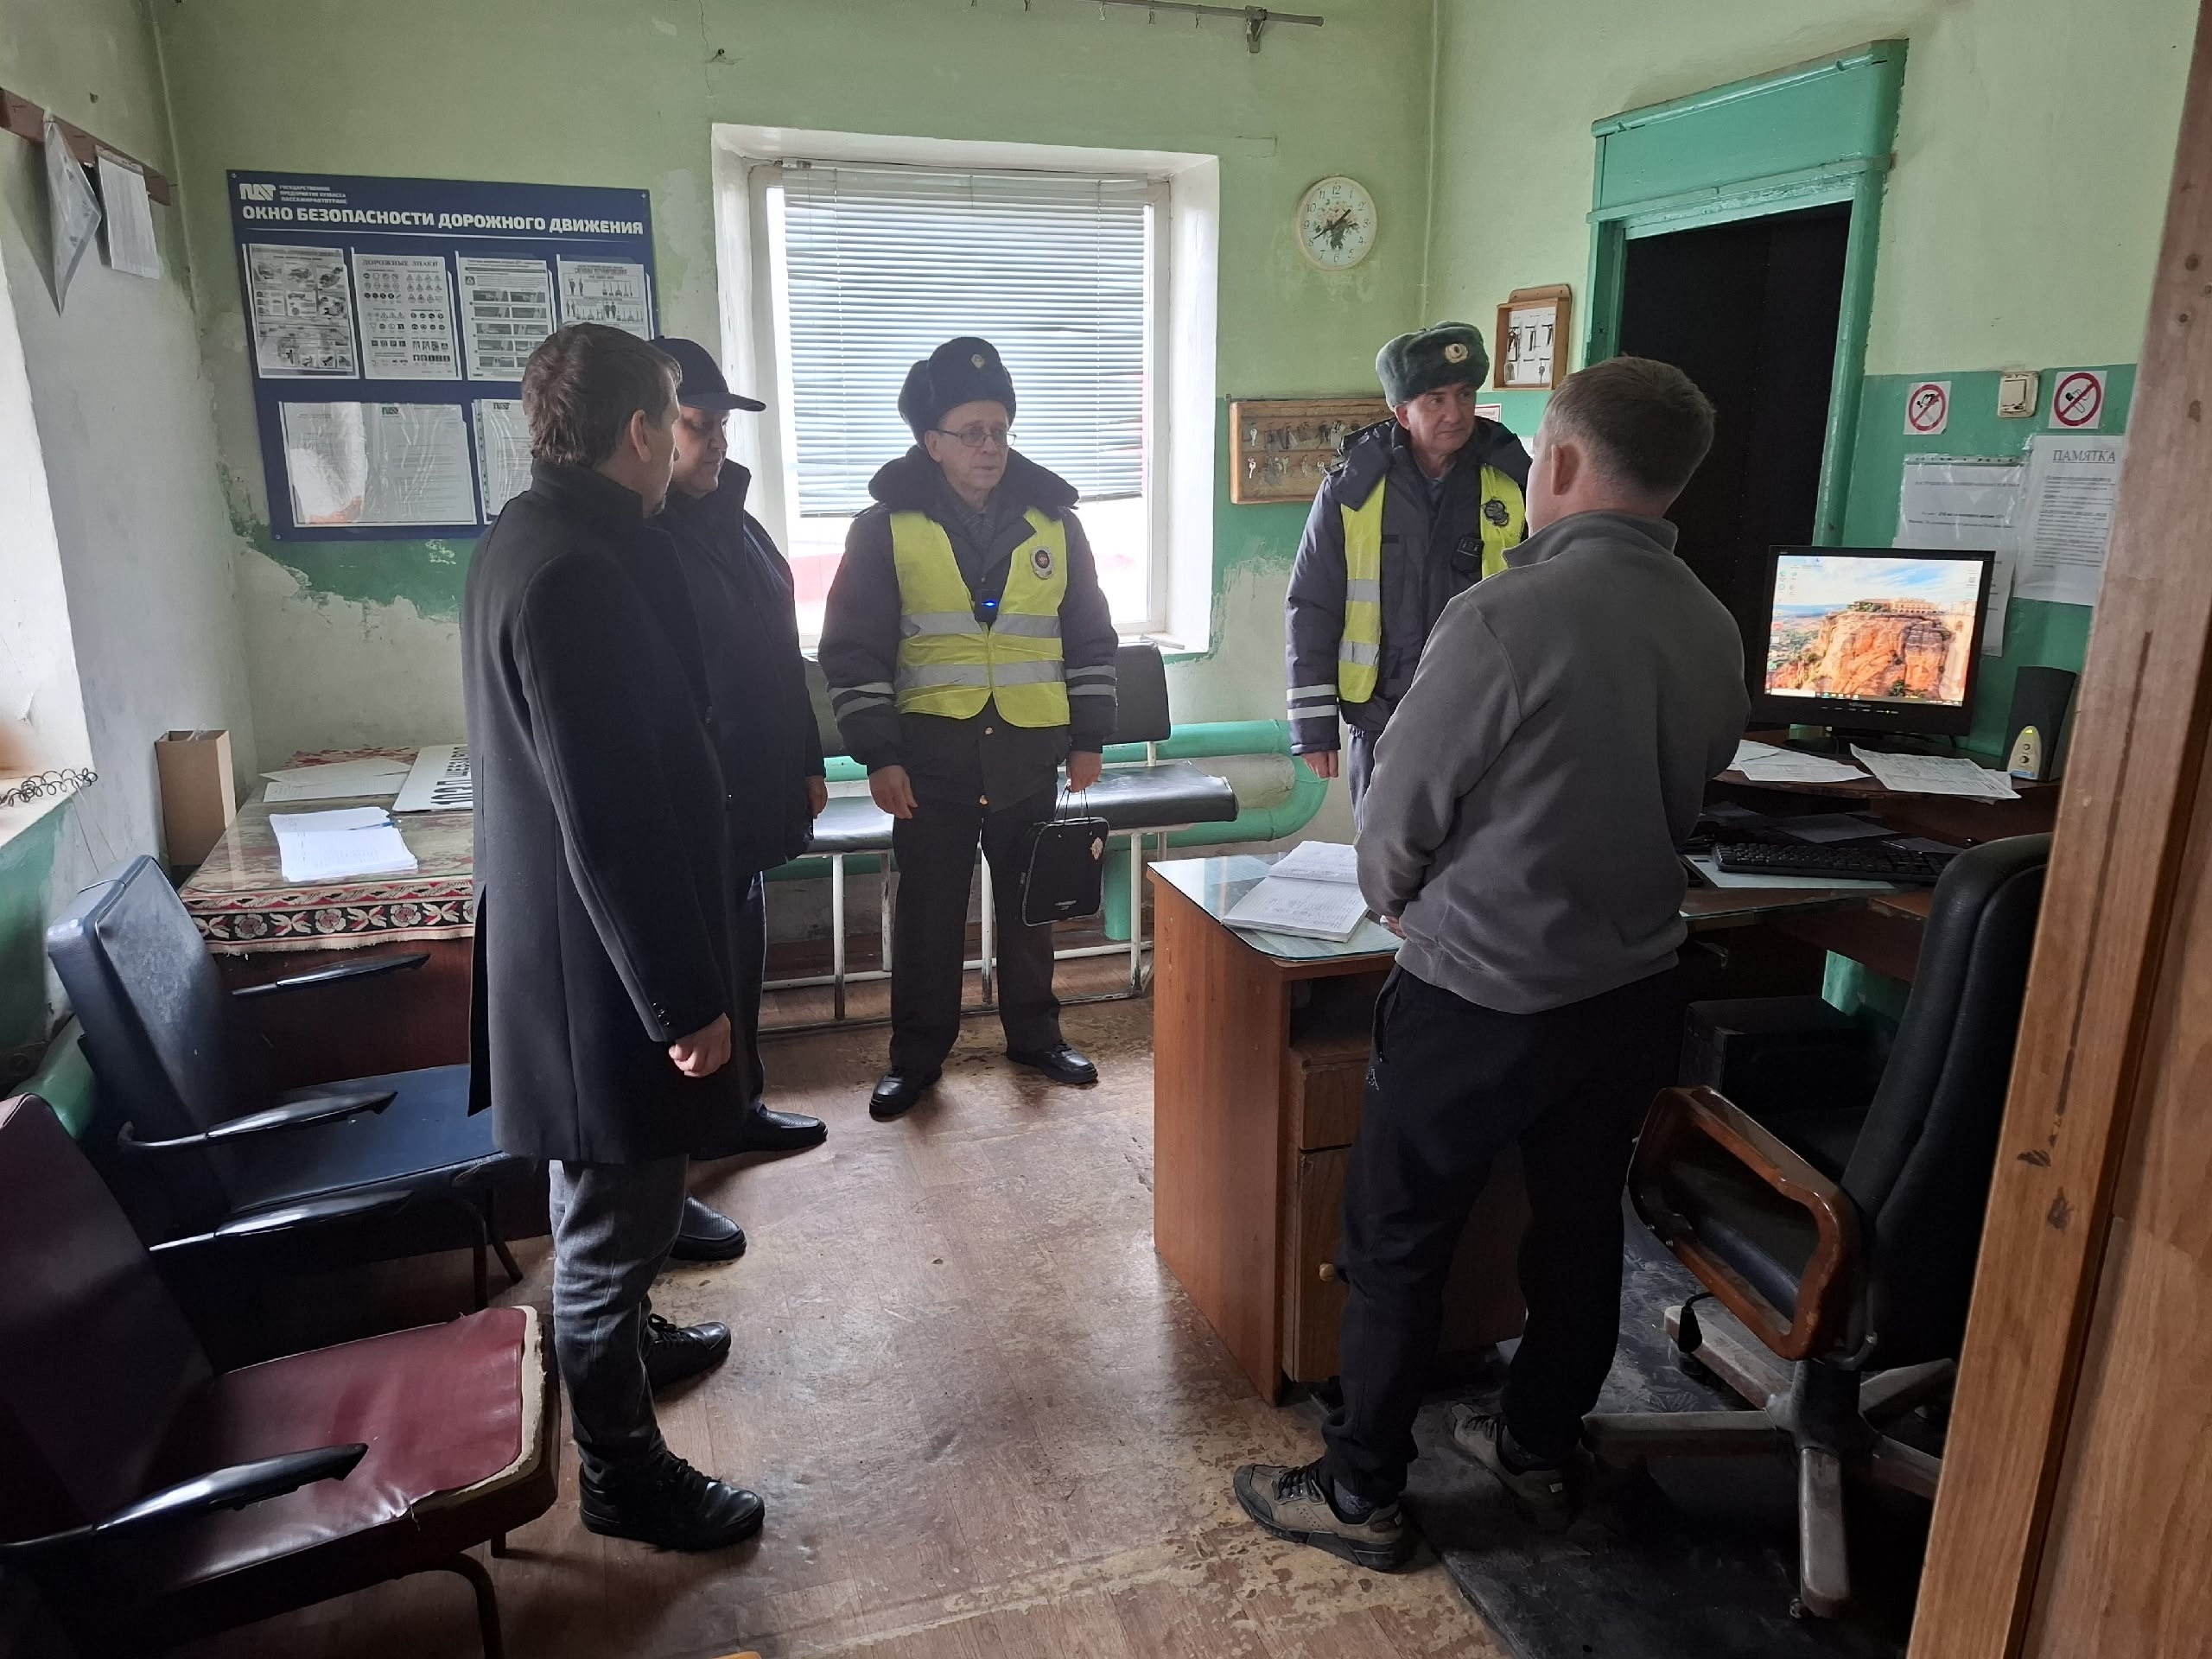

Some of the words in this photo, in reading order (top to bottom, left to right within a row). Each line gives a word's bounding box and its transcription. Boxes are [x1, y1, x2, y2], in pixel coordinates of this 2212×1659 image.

[1319, 190, 1325, 199] 11
[1332, 185, 1341, 194] 12
[1306, 203, 1317, 213] 10
[1358, 201, 1364, 211] 2
[243, 206, 294, 221] ОКНО
[296, 207, 435, 226] БЕЗОПАСНОСТИ
[438, 213, 546, 230] ДОРОЖНОГО
[550, 218, 644, 234] ДВИЖЕНИЯ
[1303, 219, 1310, 230] 9
[1333, 253, 1340, 263] 6
[1348, 249, 1354, 258] 5
[2052, 449, 2116, 463] ПАМЯТКА
